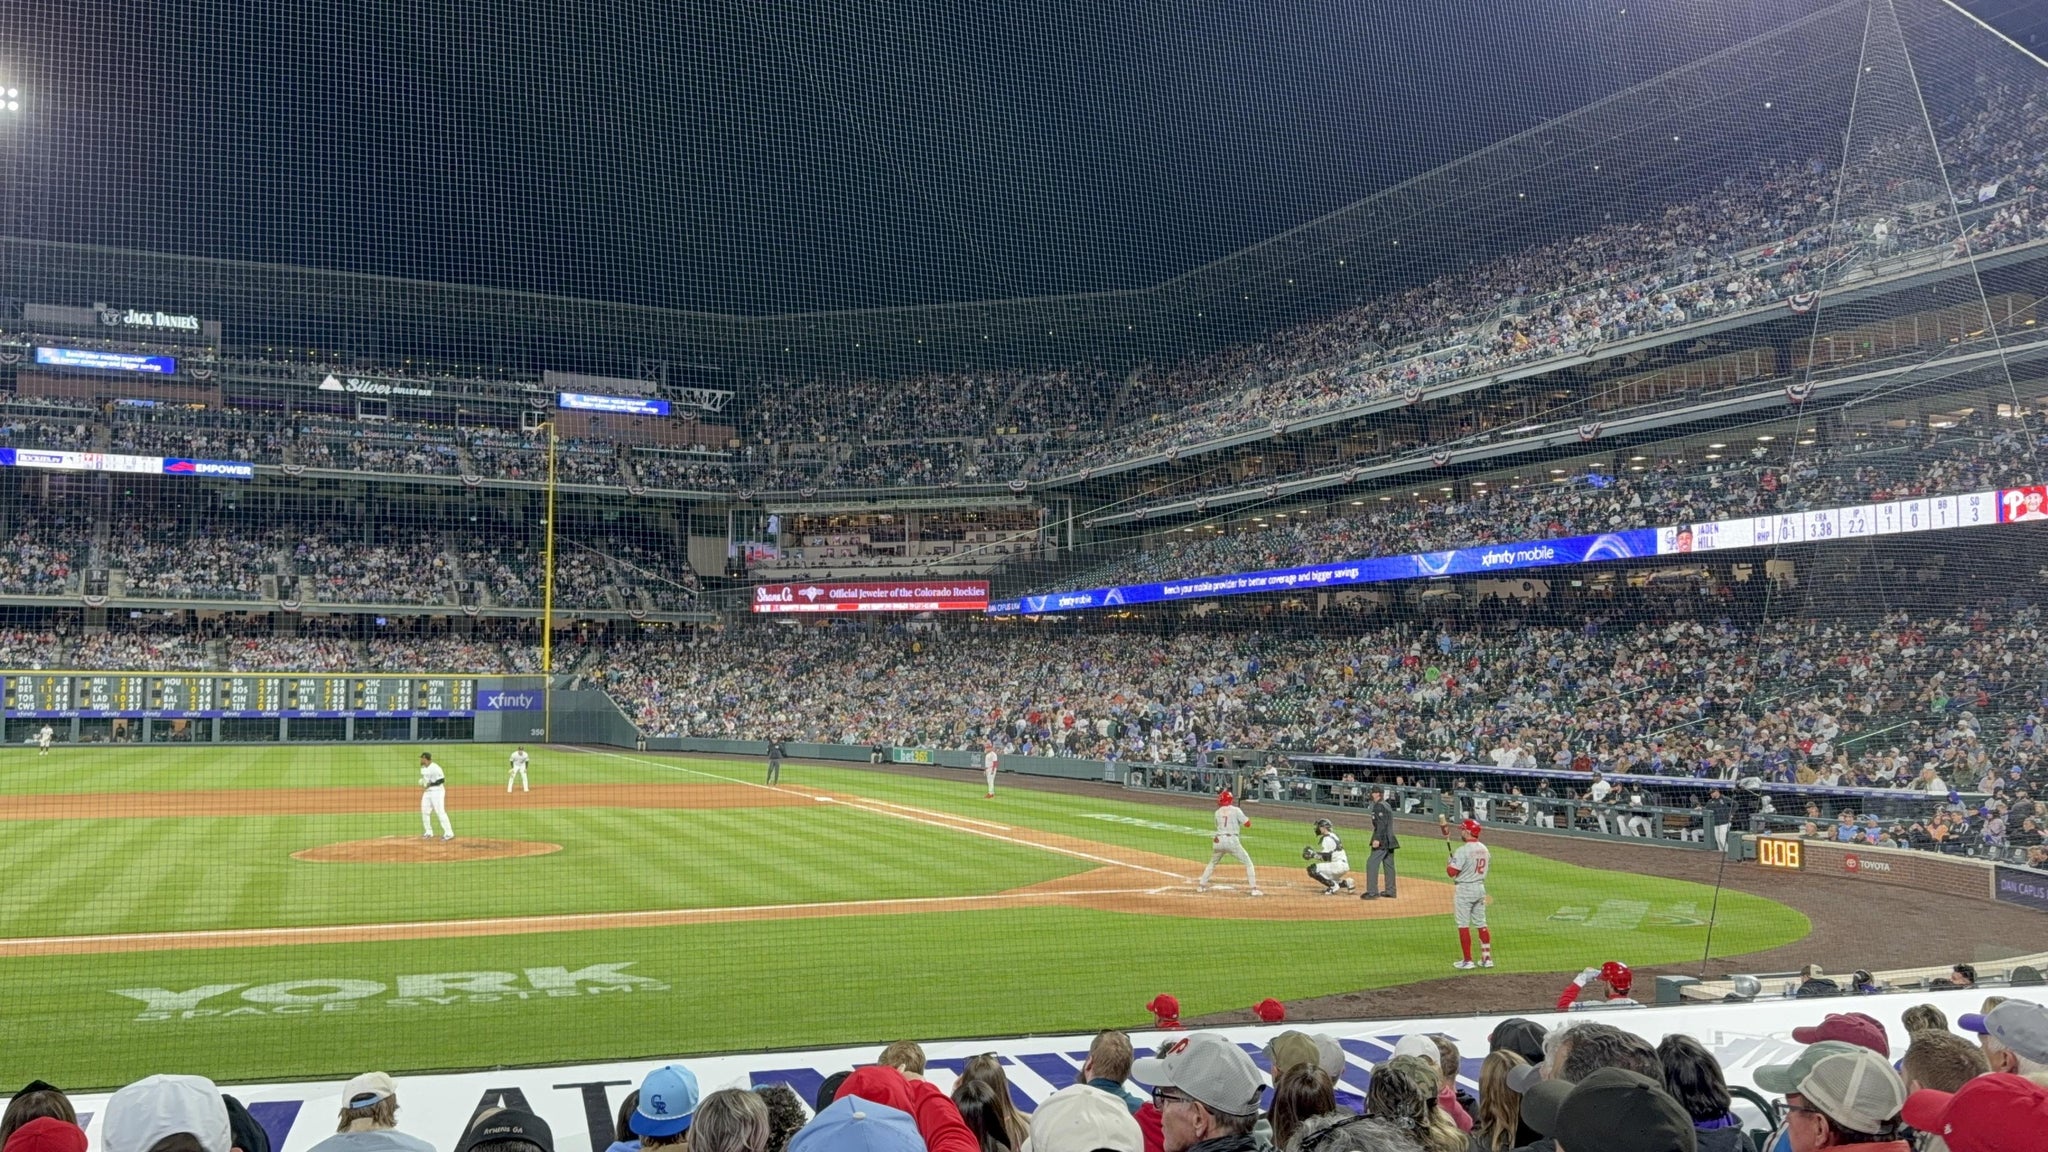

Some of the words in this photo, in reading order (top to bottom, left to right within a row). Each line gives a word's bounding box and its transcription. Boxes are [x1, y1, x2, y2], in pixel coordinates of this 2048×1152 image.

[124, 309, 153, 325] JACK
[156, 311, 199, 329] DANIEL'S
[346, 378, 392, 394] Silver
[392, 386, 418, 396] BULLET
[196, 463, 251, 476] EMPOWER
[1910, 503, 1918, 512] HR
[1970, 496, 1980, 506] SO
[2003, 490, 2025, 520] P
[1815, 512, 1827, 522] ERA
[1853, 509, 1860, 518] IP
[1884, 506, 1892, 515] ER
[1972, 508, 1979, 522] 3
[1886, 516, 1890, 530] 1
[1912, 514, 1918, 528] 0
[1941, 511, 1945, 525] 1
[1698, 524, 1719, 535] JADEN
[1811, 522, 1832, 538] 3.38
[1849, 518, 1864, 534] 2.2
[1698, 536, 1716, 549] HILL
[1757, 531, 1770, 542] RHP
[1482, 550, 1516, 567] xfinity
[1517, 545, 1554, 562] mobile
[1181, 586, 1193, 595] your
[1194, 582, 1212, 592] mobile
[1213, 580, 1237, 592] provider
[1238, 578, 1247, 588] for
[1268, 574, 1296, 586] coverage
[1298, 572, 1310, 582] and
[1312, 570, 1332, 582] bigger
[1334, 566, 1359, 580] savings
[830, 588, 858, 599] Official
[859, 588, 888, 600] Jeweler
[890, 588, 898, 598] of
[899, 588, 912, 598] the
[914, 587, 951, 598] Colorado
[953, 586, 985, 597] Rockies
[164, 678, 181, 686] HOU
[18, 685, 32, 693] DET
[18, 694, 34, 702] TOR
[488, 692, 534, 709] xfinity
[530, 728, 544, 736] 350
[1222, 816, 1228, 828] 7
[1474, 858, 1486, 874] 12
[1860, 860, 1890, 871] TOYOTA
[2001, 879, 2017, 892] DAN
[105, 961, 664, 1010] YORK
[133, 1000, 359, 1021] SPACE
[386, 983, 672, 1008] SYSTEMS
[650, 1094, 668, 1114] CR
[484, 1126, 510, 1136] ATHENS
[512, 1126, 524, 1134] GA
